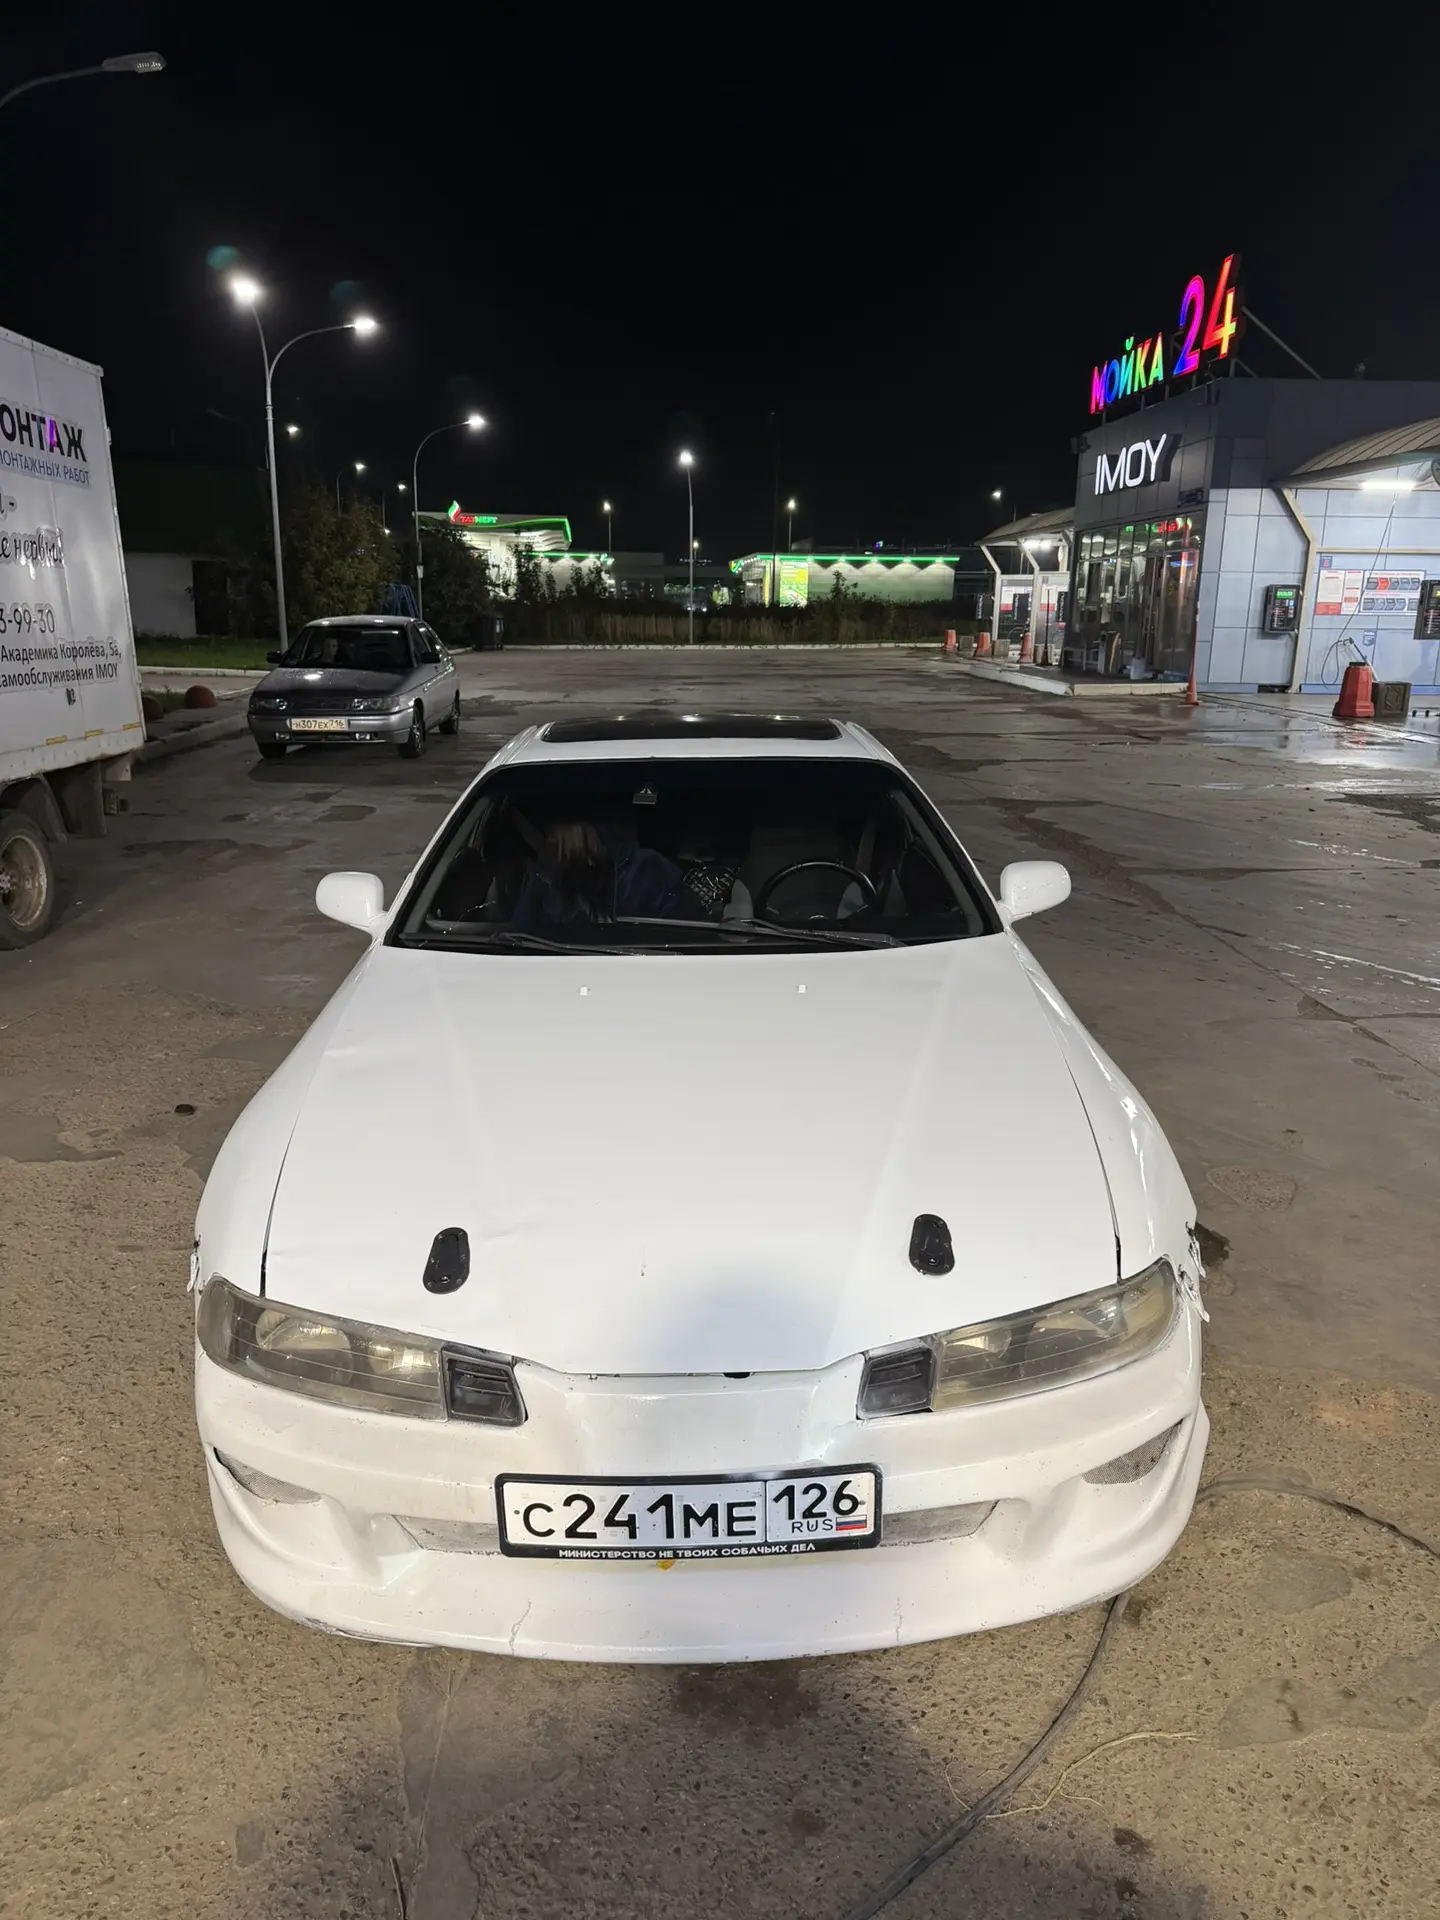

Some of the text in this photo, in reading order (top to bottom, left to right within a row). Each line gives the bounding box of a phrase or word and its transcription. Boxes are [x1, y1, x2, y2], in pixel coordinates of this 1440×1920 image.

[1090, 253, 1237, 415] МОЙКА 24
[1095, 433, 1167, 495] IMOY
[63, 464, 90, 485] РАБОТ
[1, 645, 58, 665] Академика
[95, 662, 119, 679] IMOY
[522, 1479, 860, 1540] С241МЕ 126
[791, 1516, 834, 1534] RUS
[558, 1542, 816, 1559] МИНИСТЕРСТВО НЕ ТВОИХ СОБАЧЬИХ ДЕЛ
